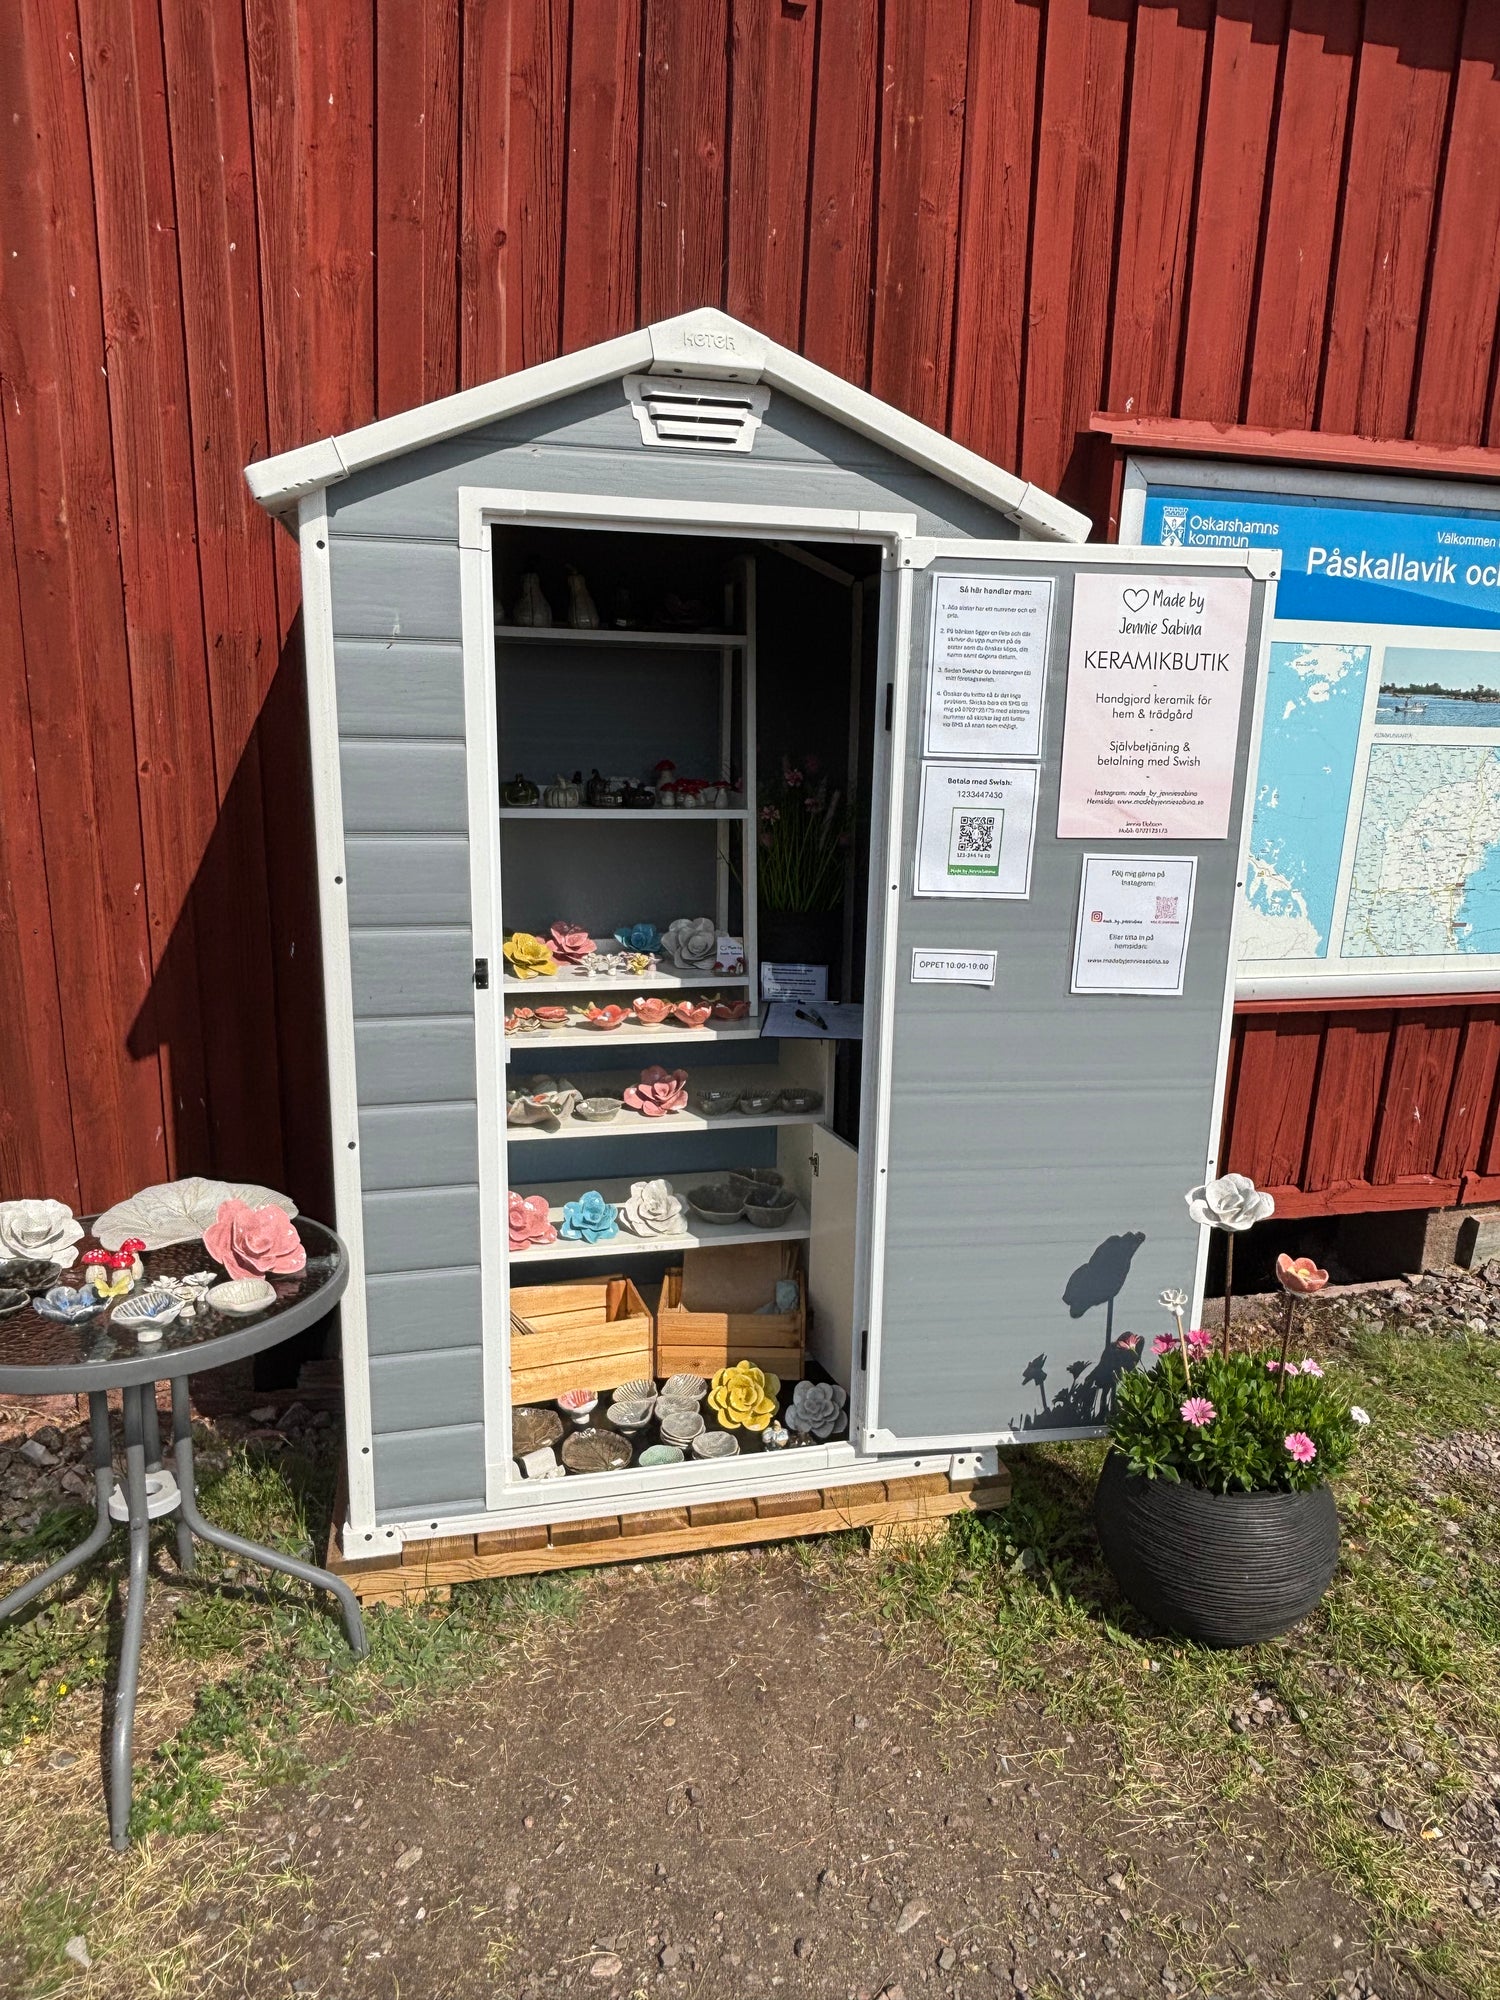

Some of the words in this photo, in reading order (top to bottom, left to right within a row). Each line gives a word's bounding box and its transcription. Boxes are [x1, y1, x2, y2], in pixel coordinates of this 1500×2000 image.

[1189, 515, 1279, 536] Oskarshamns
[1189, 531, 1249, 548] kommun
[1437, 532, 1495, 547] Välkommen
[1307, 547, 1458, 584] Påskallavik
[959, 585, 969, 593] Så
[970, 586, 982, 594] här
[984, 587, 1012, 595] handlar
[1153, 589, 1186, 607] Made
[1189, 591, 1204, 614] by
[1119, 617, 1158, 634] Jennie
[1161, 618, 1202, 636] Sabina
[1084, 650, 1230, 671] KERAMIKBUTIK
[1096, 693, 1151, 706] Handgjord
[1154, 694, 1194, 705] keramik
[1198, 694, 1212, 705] för
[1112, 708, 1134, 719] hem
[1137, 709, 1146, 719] &
[1149, 709, 1193, 721] trädgård
[1109, 741, 1179, 753] Självbetjäning
[1183, 742, 1190, 751] &
[1097, 755, 1148, 768] betalning
[1148, 756, 1170, 766] med
[1173, 756, 1201, 767] Swish
[948, 777, 970, 785] Betala
[1146, 934, 1154, 942] på
